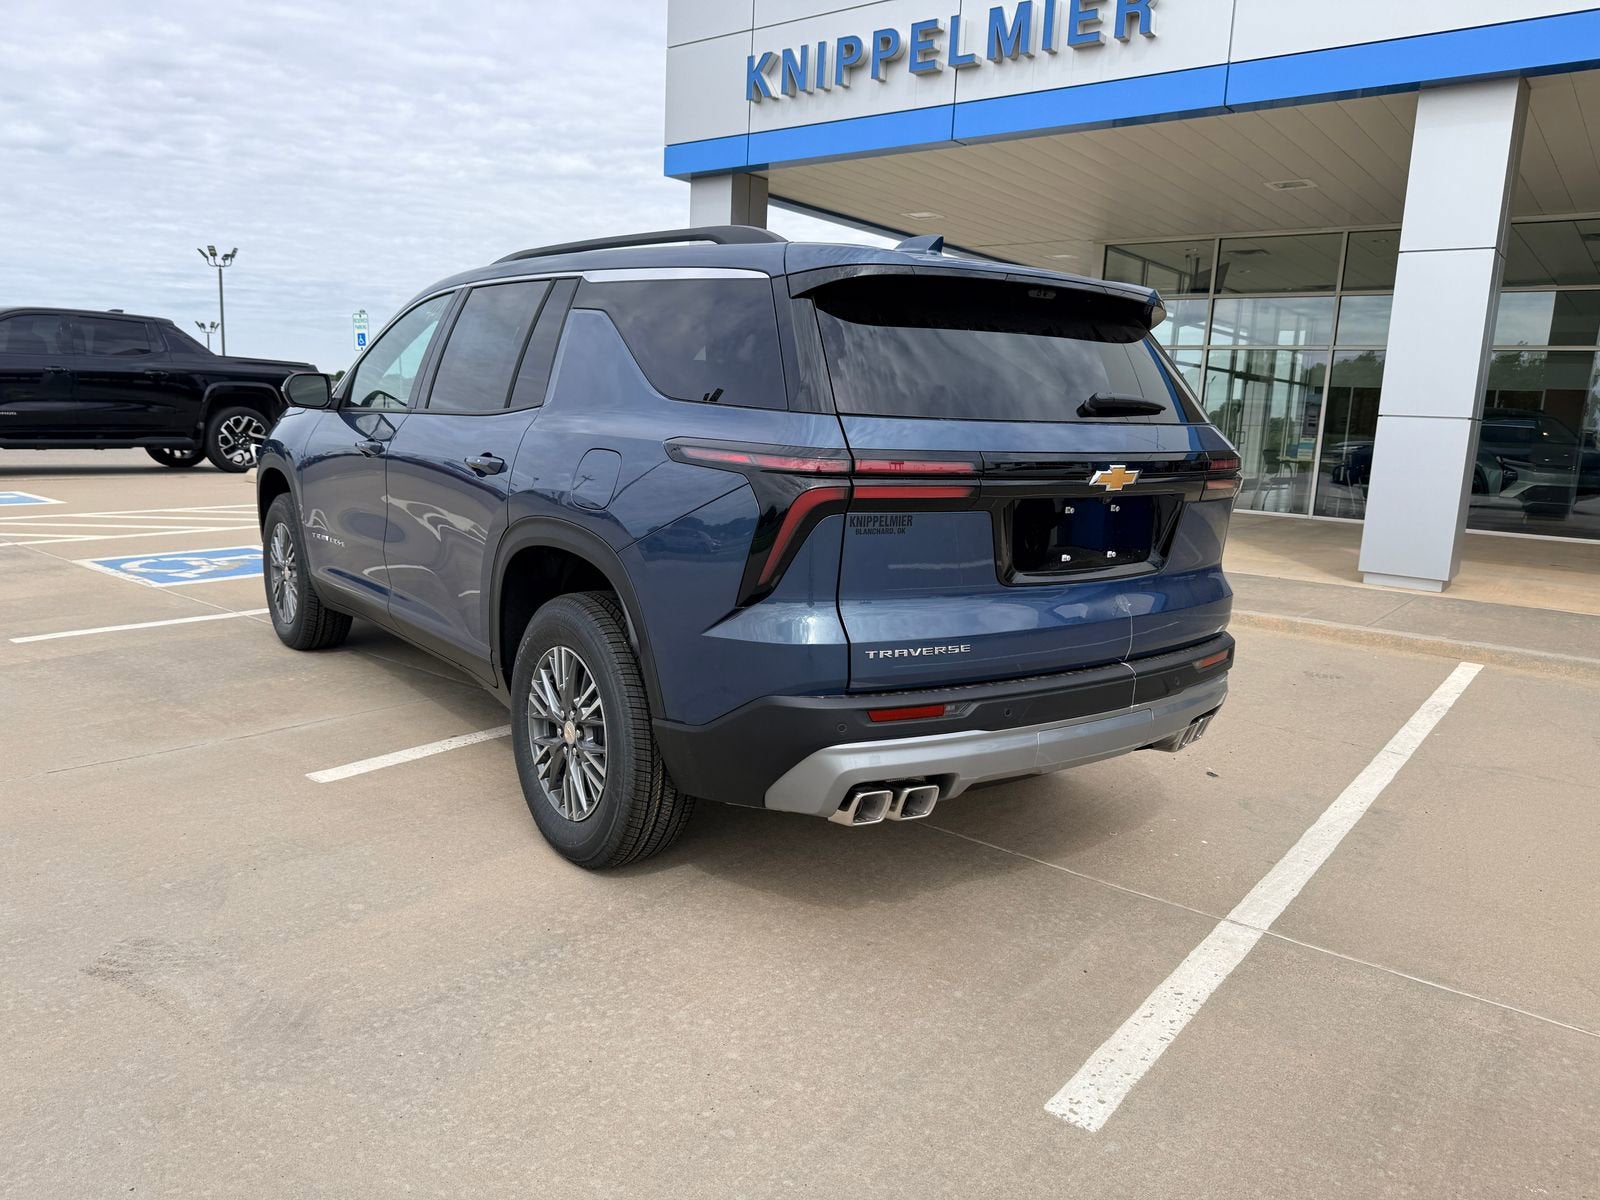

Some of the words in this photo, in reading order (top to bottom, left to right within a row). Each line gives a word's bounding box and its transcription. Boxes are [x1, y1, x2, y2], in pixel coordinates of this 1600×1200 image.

[746, 0, 1157, 101] KNIPPELMIER
[849, 515, 913, 528] KNIPPELMIER
[855, 527, 897, 536] BLANCHARD,
[897, 527, 907, 535] OK
[865, 644, 971, 660] TRAVERSE
